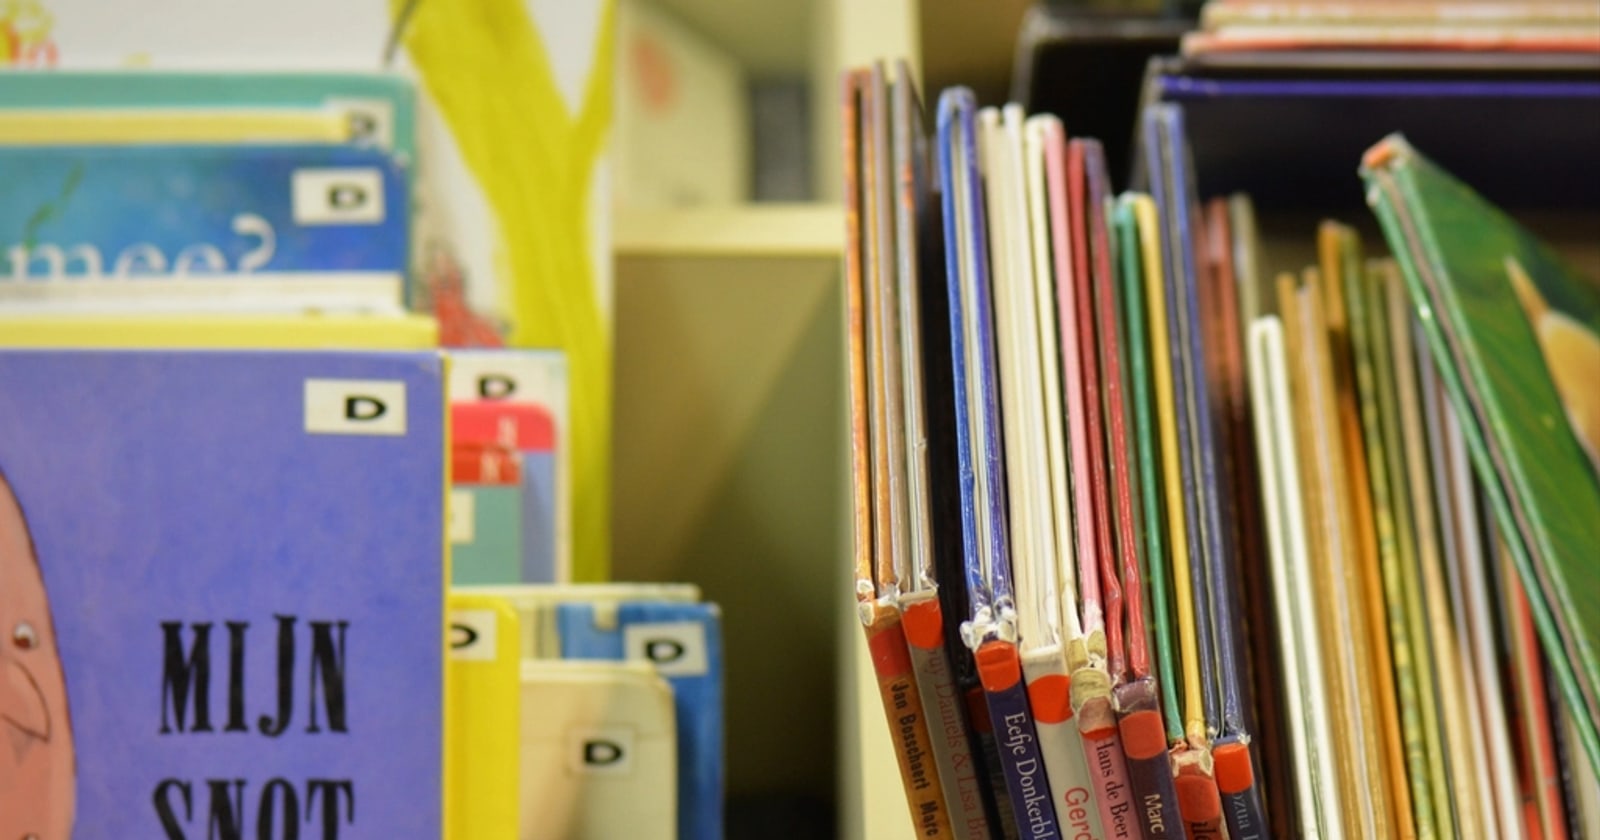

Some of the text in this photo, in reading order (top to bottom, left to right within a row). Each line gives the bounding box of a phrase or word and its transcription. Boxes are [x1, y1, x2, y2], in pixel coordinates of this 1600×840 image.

[328, 184, 367, 209] D
[477, 375, 516, 399] D
[345, 396, 387, 420] D
[645, 639, 685, 663] D
[924, 649, 945, 675] uy
[160, 614, 349, 738] MIJN
[583, 740, 624, 766] D
[891, 682, 939, 837] Jan Bosschaert Marc
[1005, 712, 1055, 840] Eefje Donkerbl
[1105, 781, 1124, 801] de
[1109, 801, 1130, 838] Beer
[1144, 793, 1165, 834] Marc
